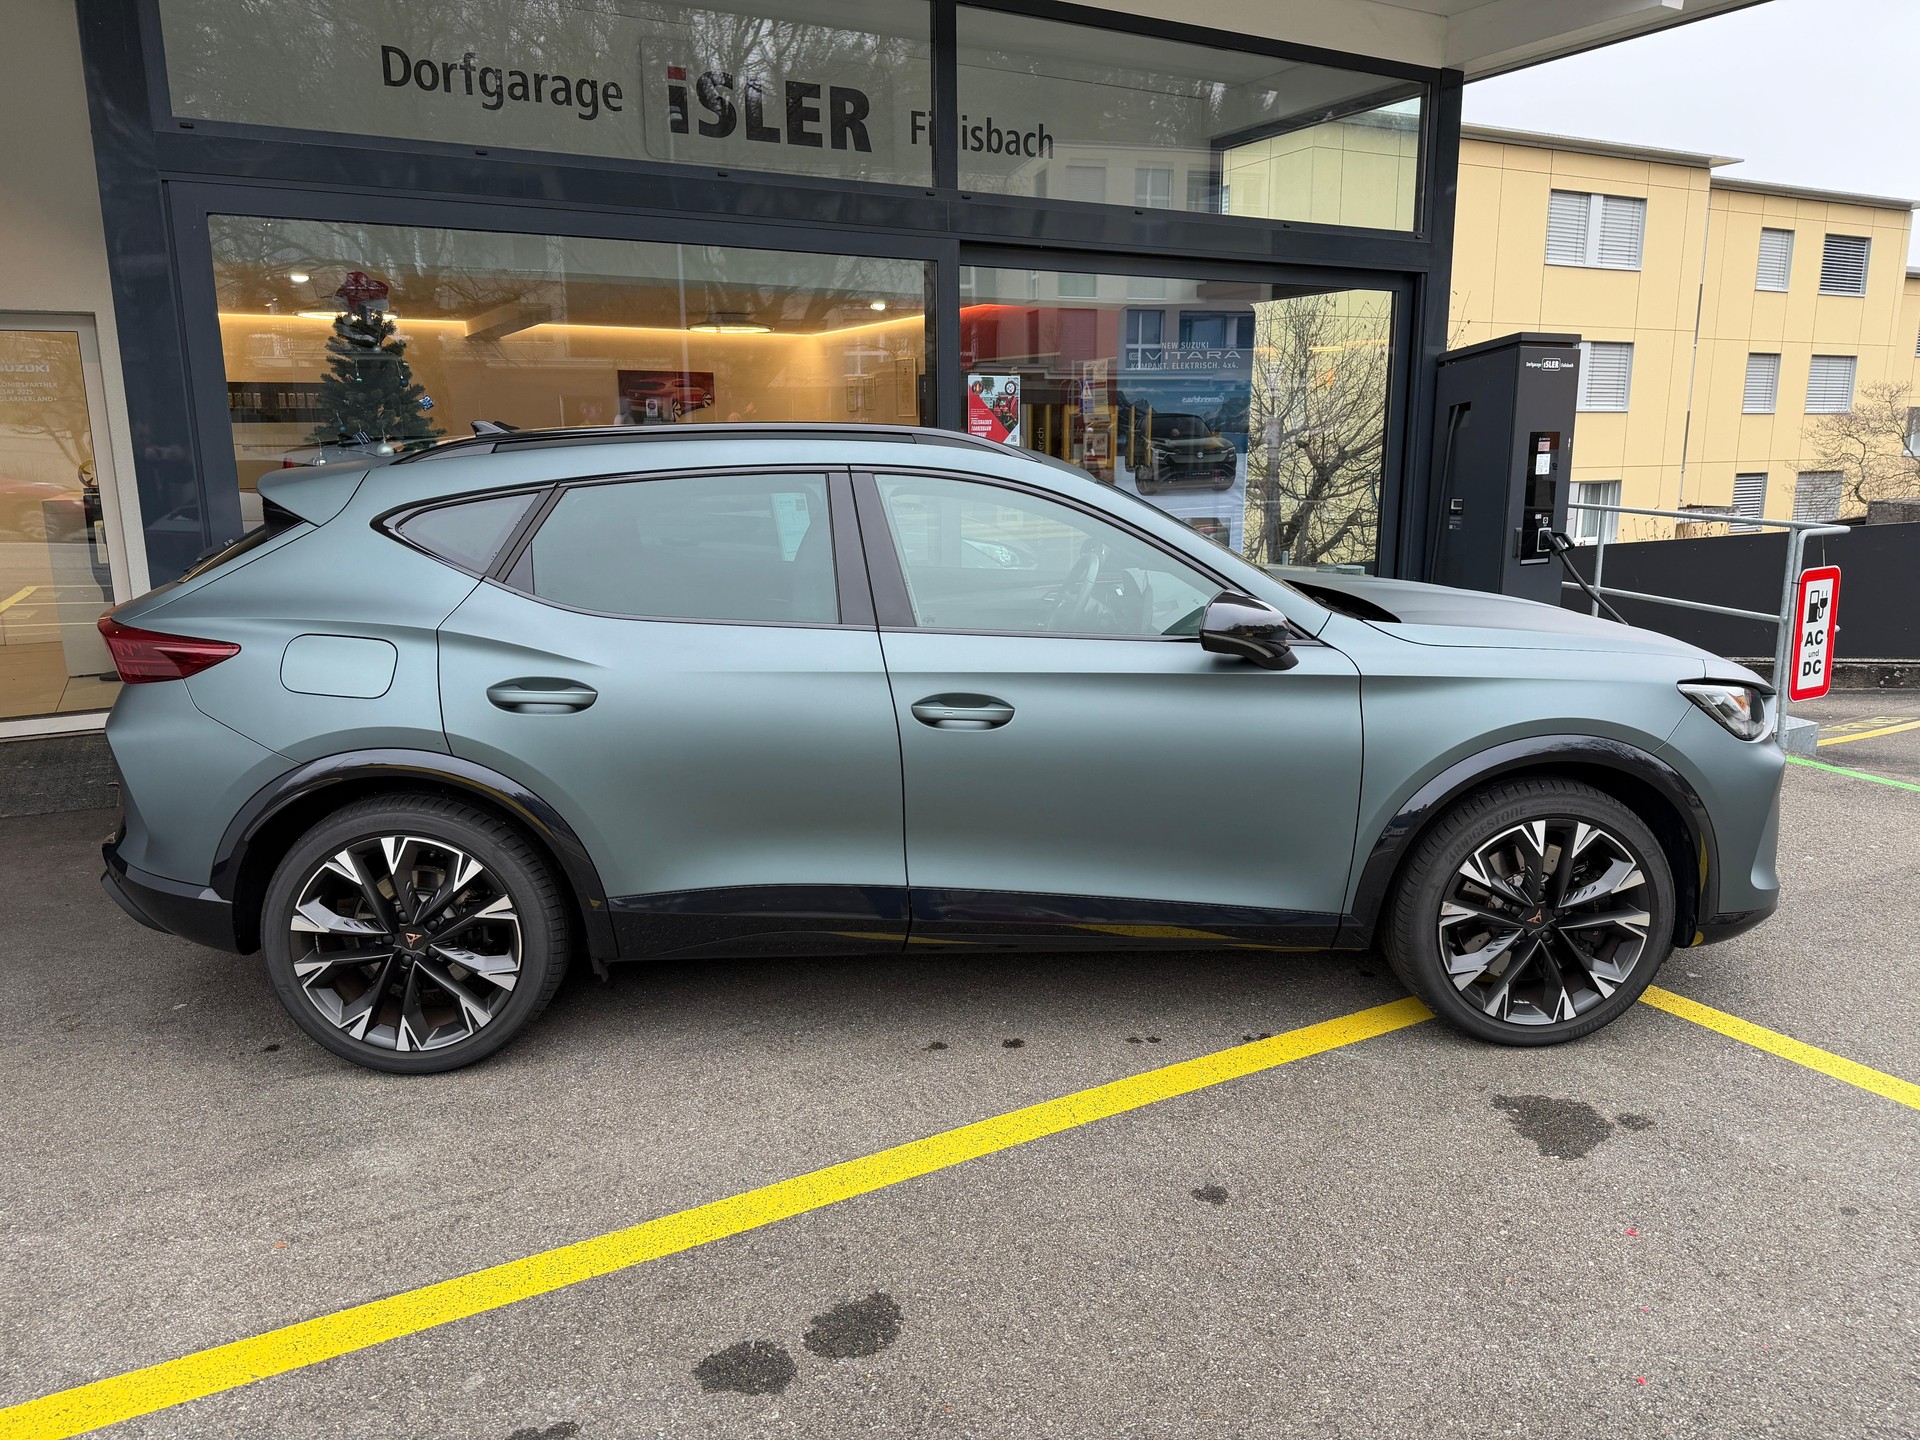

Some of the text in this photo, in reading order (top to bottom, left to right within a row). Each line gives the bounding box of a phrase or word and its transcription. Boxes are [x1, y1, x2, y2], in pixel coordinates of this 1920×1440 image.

[381, 45, 1053, 159] Dorfgarage iSLER Fiisbach
[1180, 341, 1209, 349] SUZUKI
[1145, 350, 1241, 361] VITARA
[1130, 361, 1239, 370] KOMPAKT. ELEKTRISCH. 4x4.
[1804, 629, 1824, 647] AC
[1808, 649, 1820, 658] und
[1802, 659, 1822, 677] DC
[1444, 804, 1527, 864] BRIDGESTONE
